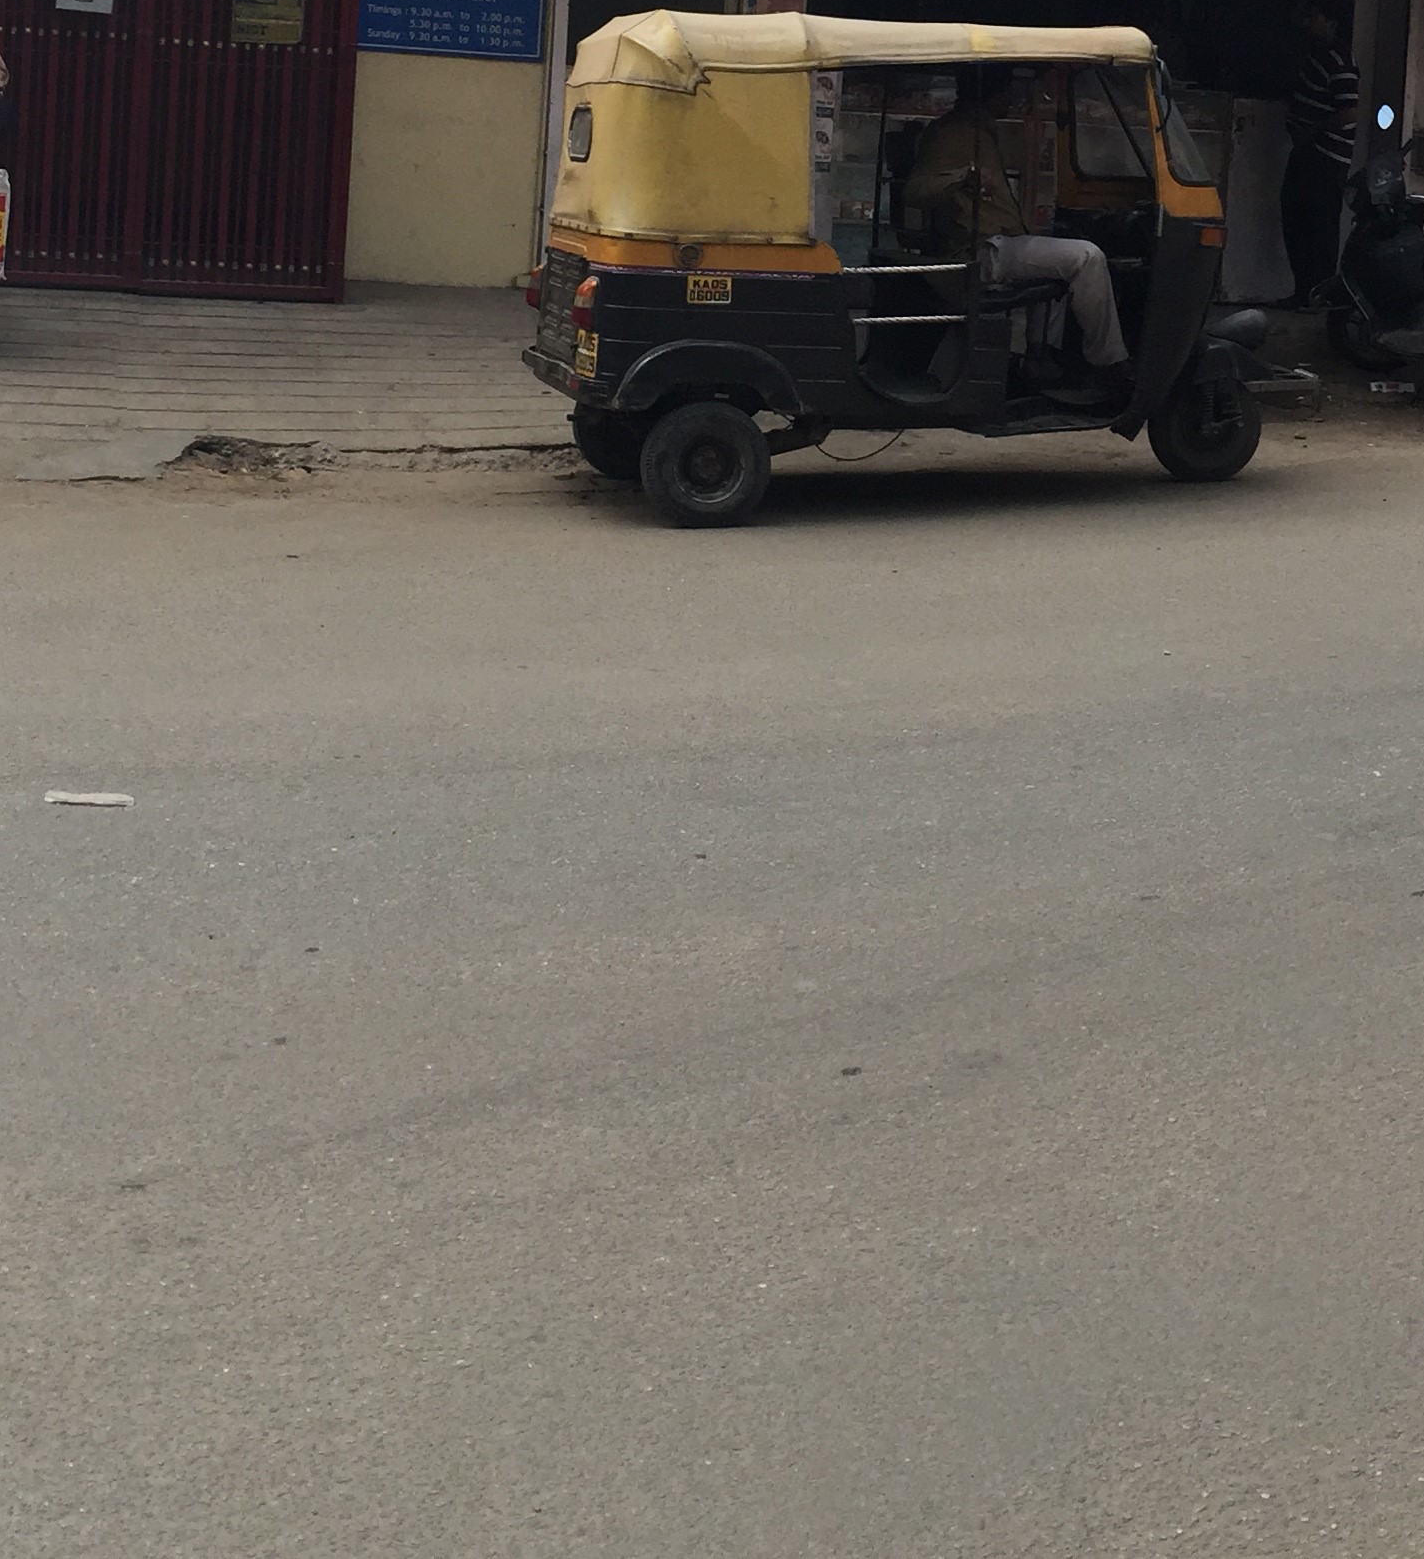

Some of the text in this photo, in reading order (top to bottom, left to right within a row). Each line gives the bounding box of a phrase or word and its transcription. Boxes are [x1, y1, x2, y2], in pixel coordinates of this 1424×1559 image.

[367, 3, 432, 17] Timings 9.30
[367, 28, 401, 41] Sunday
